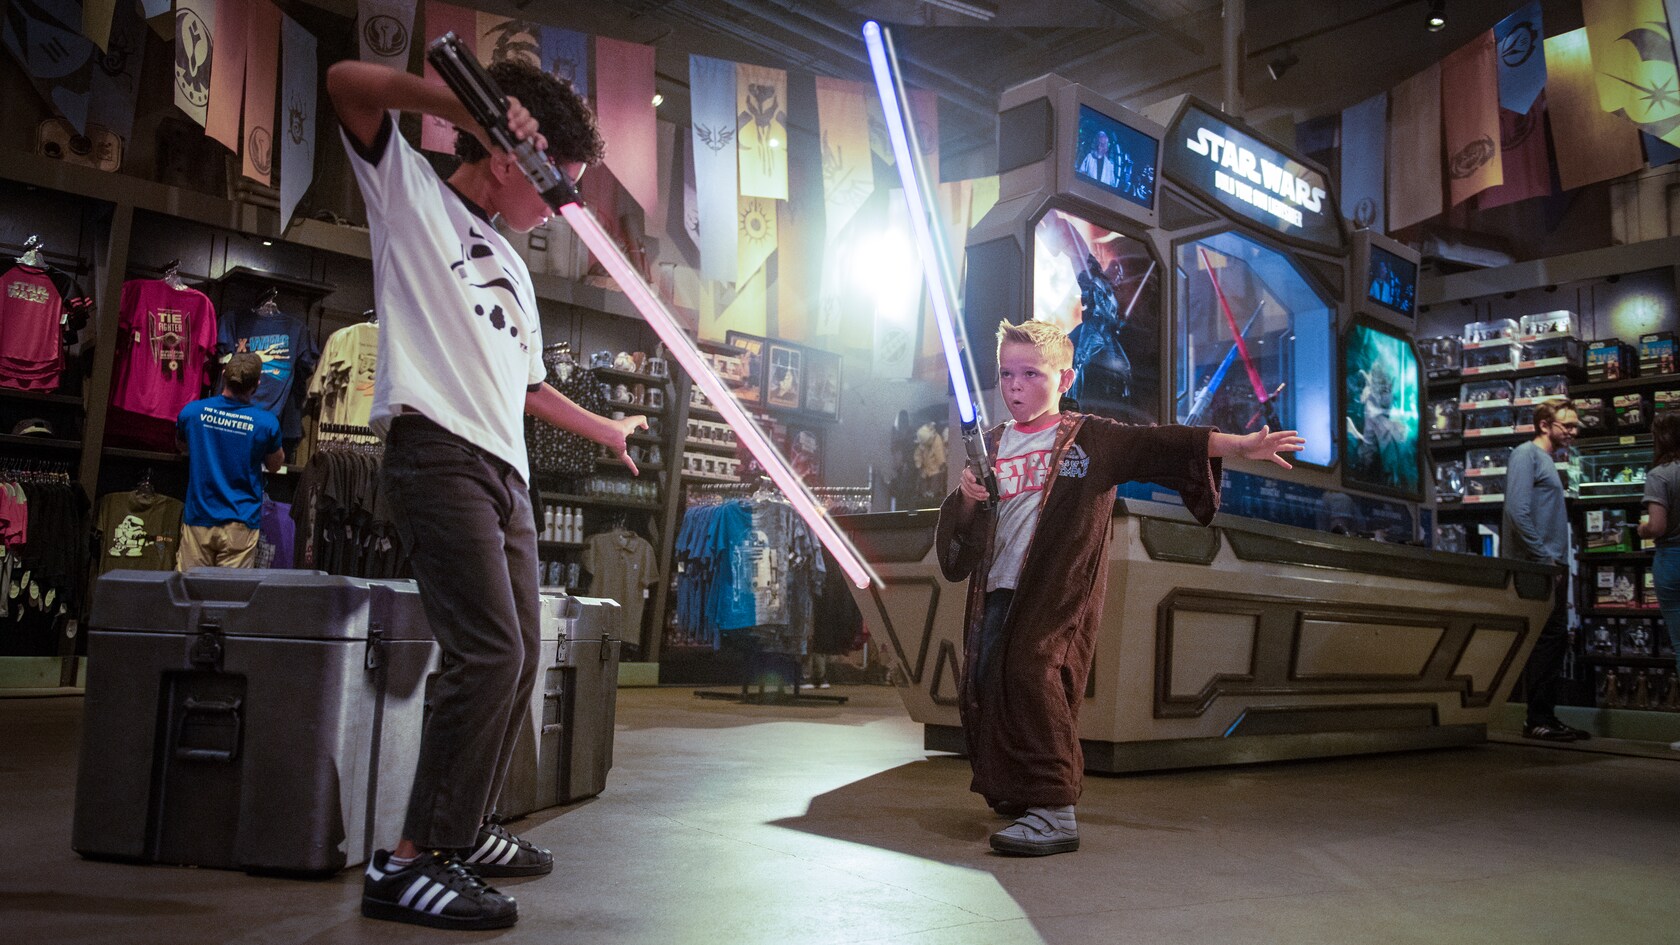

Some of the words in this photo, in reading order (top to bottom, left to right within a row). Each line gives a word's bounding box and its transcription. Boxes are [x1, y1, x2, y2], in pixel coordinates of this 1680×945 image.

[1187, 127, 1261, 184] STAR
[1260, 158, 1326, 213] WARS
[8, 281, 49, 297] STAR
[8, 288, 49, 304] WARS
[157, 312, 182, 323] TIE
[158, 322, 183, 332] FIGHTER
[200, 413, 254, 431] VOLUNTEER
